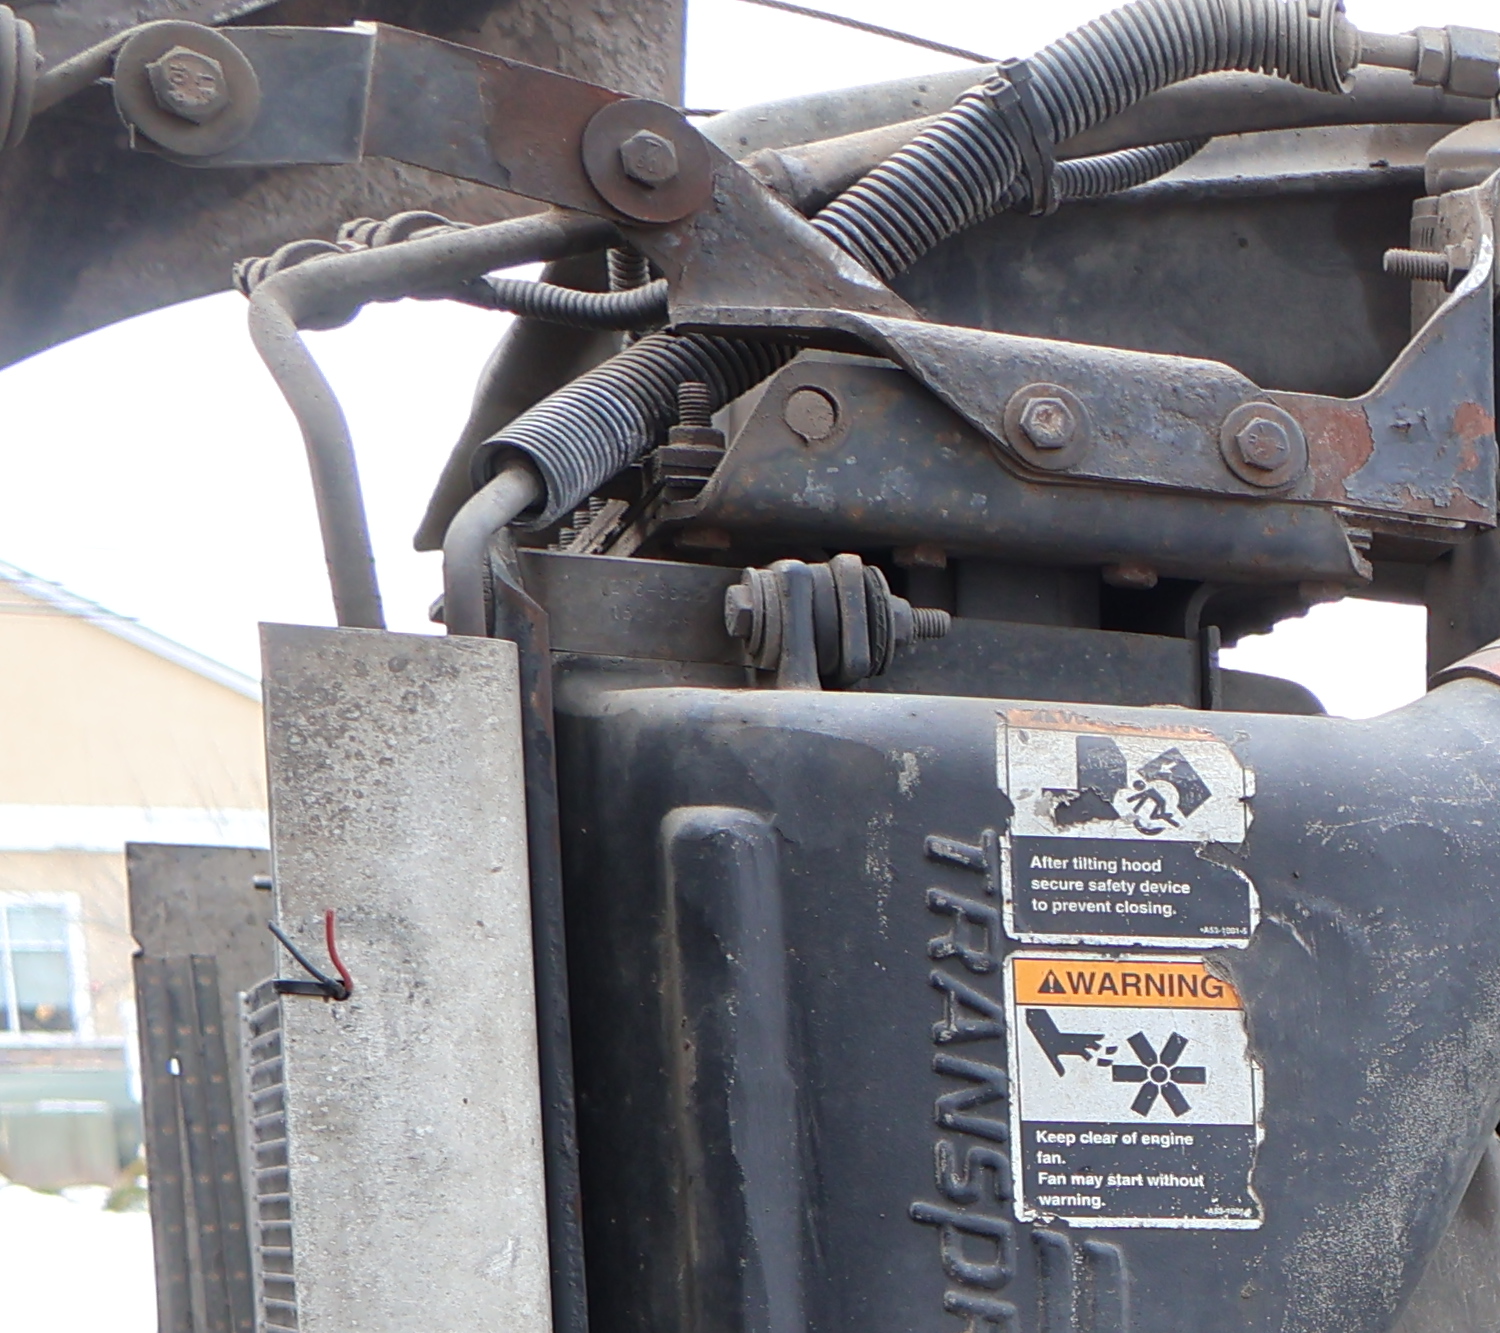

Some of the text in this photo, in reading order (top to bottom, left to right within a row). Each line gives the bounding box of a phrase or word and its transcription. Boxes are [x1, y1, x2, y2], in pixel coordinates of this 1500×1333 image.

[1030, 855, 1162, 873] After tilting hood
[1031, 879, 1191, 896] secure safety device
[1031, 899, 1177, 917] to prevent closing.
[1066, 971, 1224, 998] WARNING
[1036, 1131, 1194, 1148] Keep clear of engine
[1037, 1151, 1067, 1164] fan.
[1038, 1173, 1205, 1188] Fan may start without
[1038, 1194, 1106, 1208] warning.
